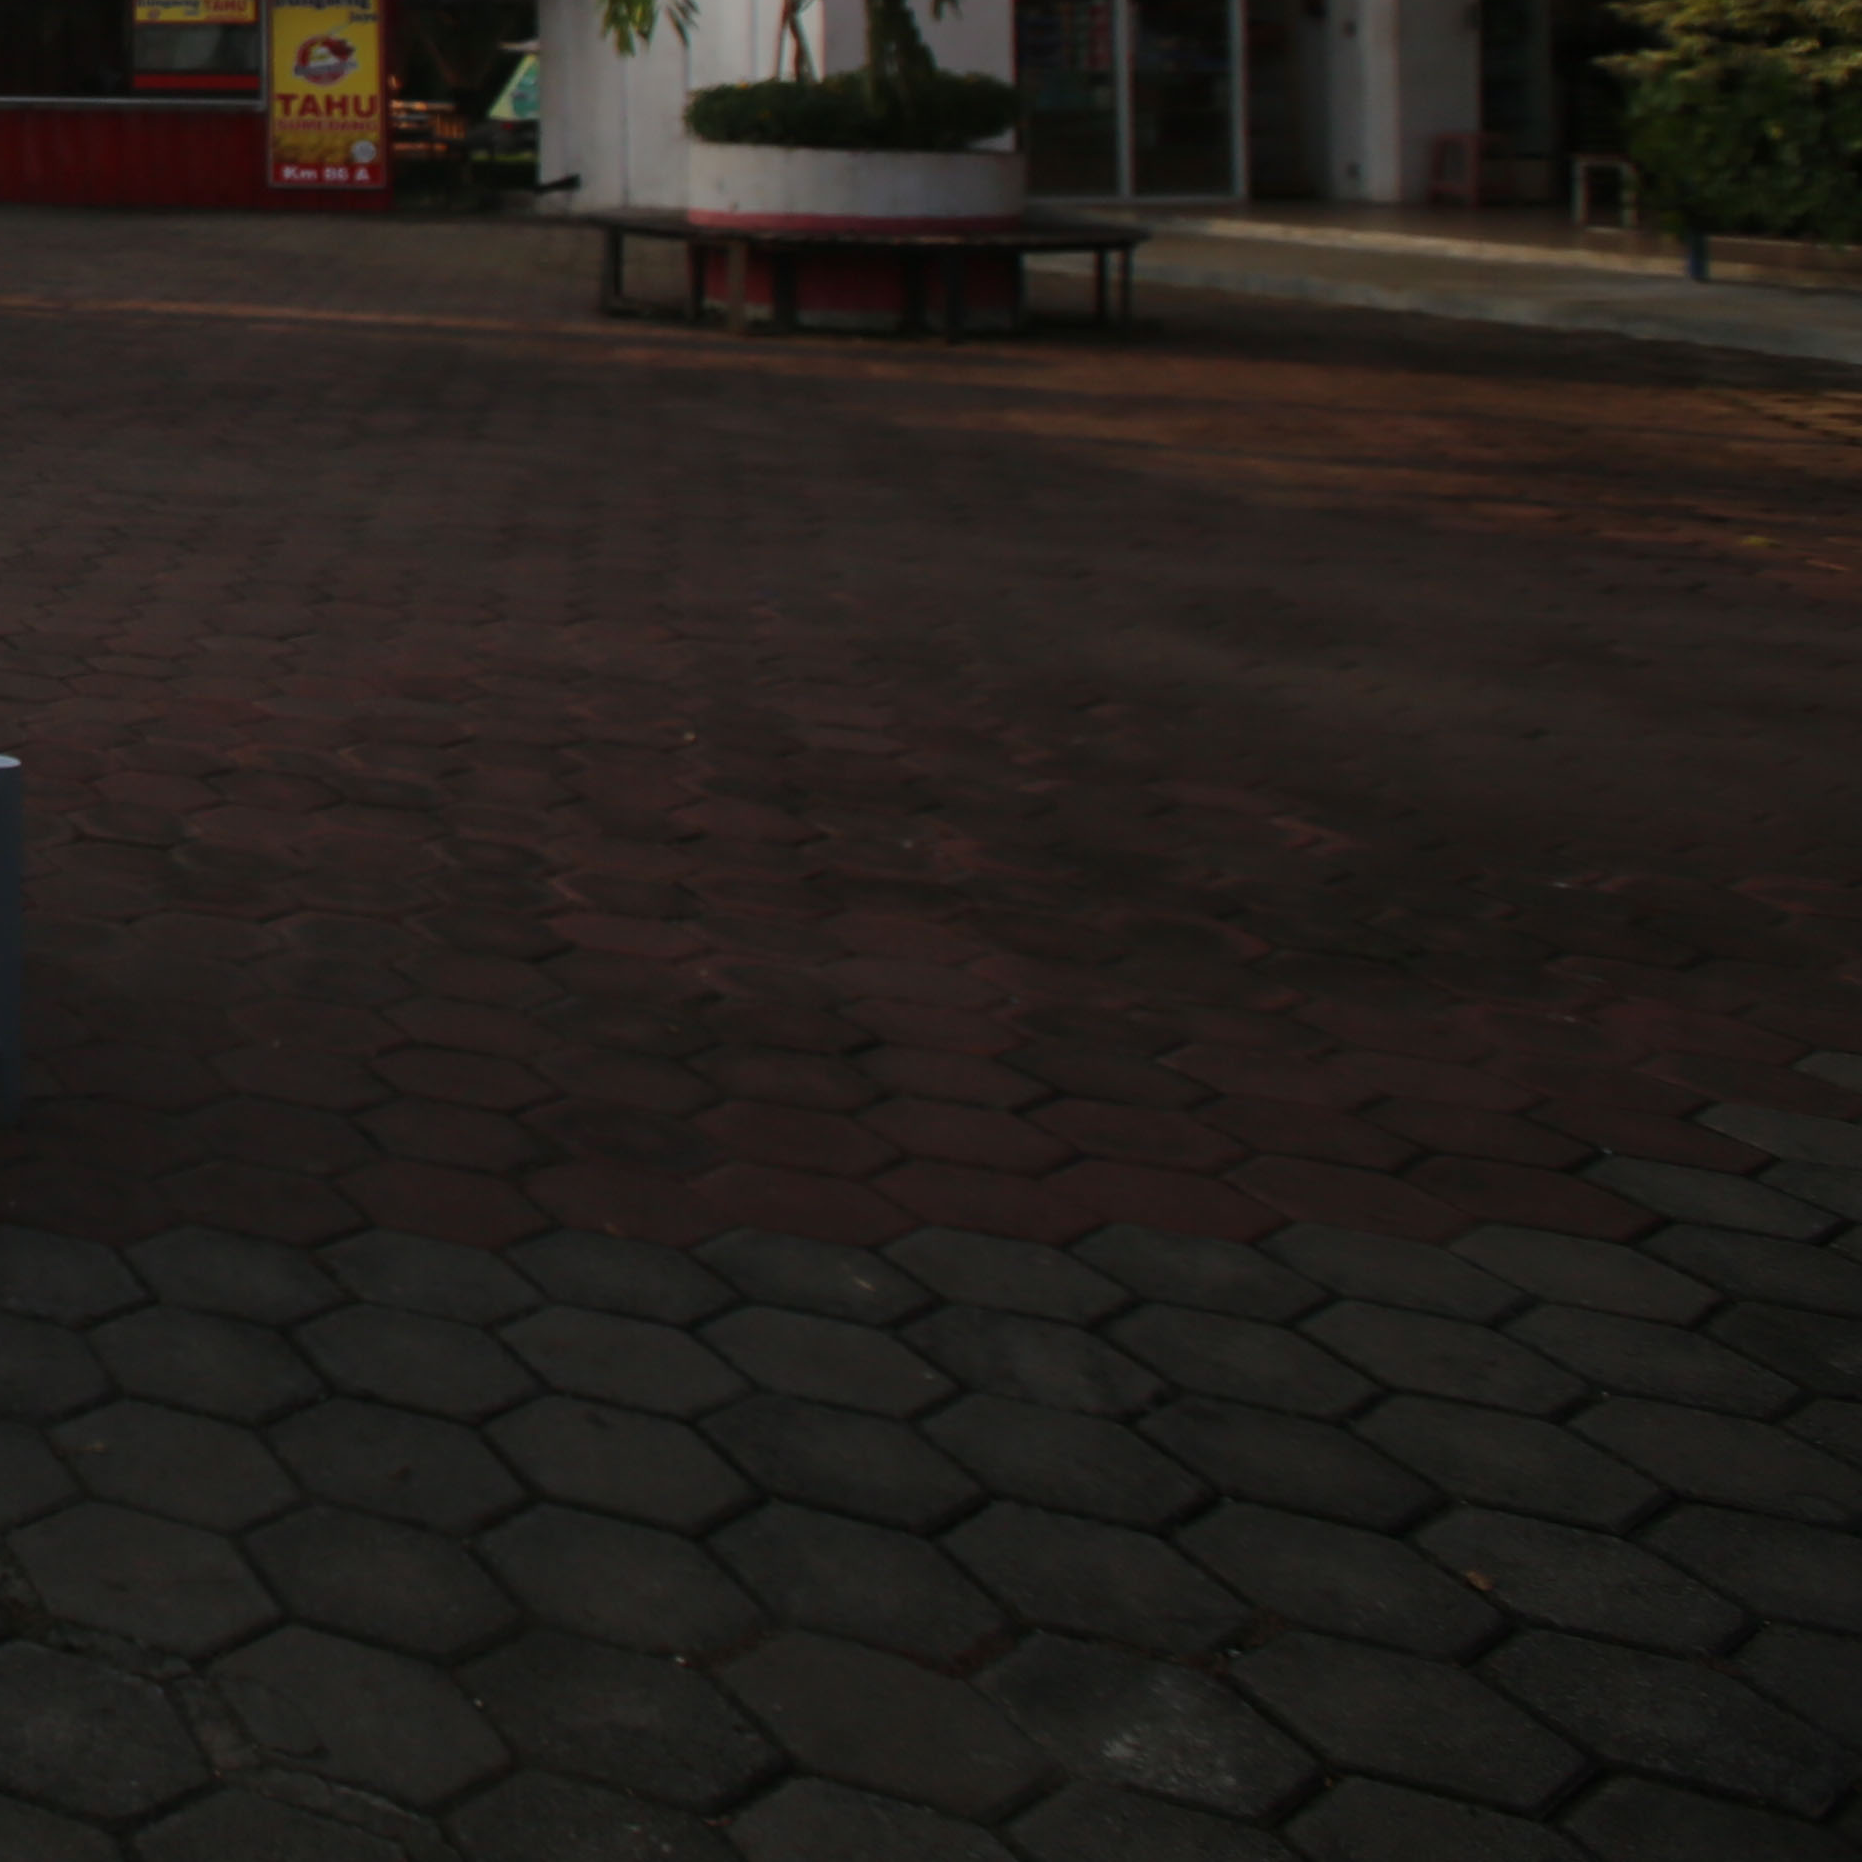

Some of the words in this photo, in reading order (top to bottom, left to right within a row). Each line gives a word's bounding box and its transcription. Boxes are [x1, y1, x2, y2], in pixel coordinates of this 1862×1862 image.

[276, 94, 378, 118] TAHU
[281, 165, 319, 182] Km
[353, 165, 371, 182] A
